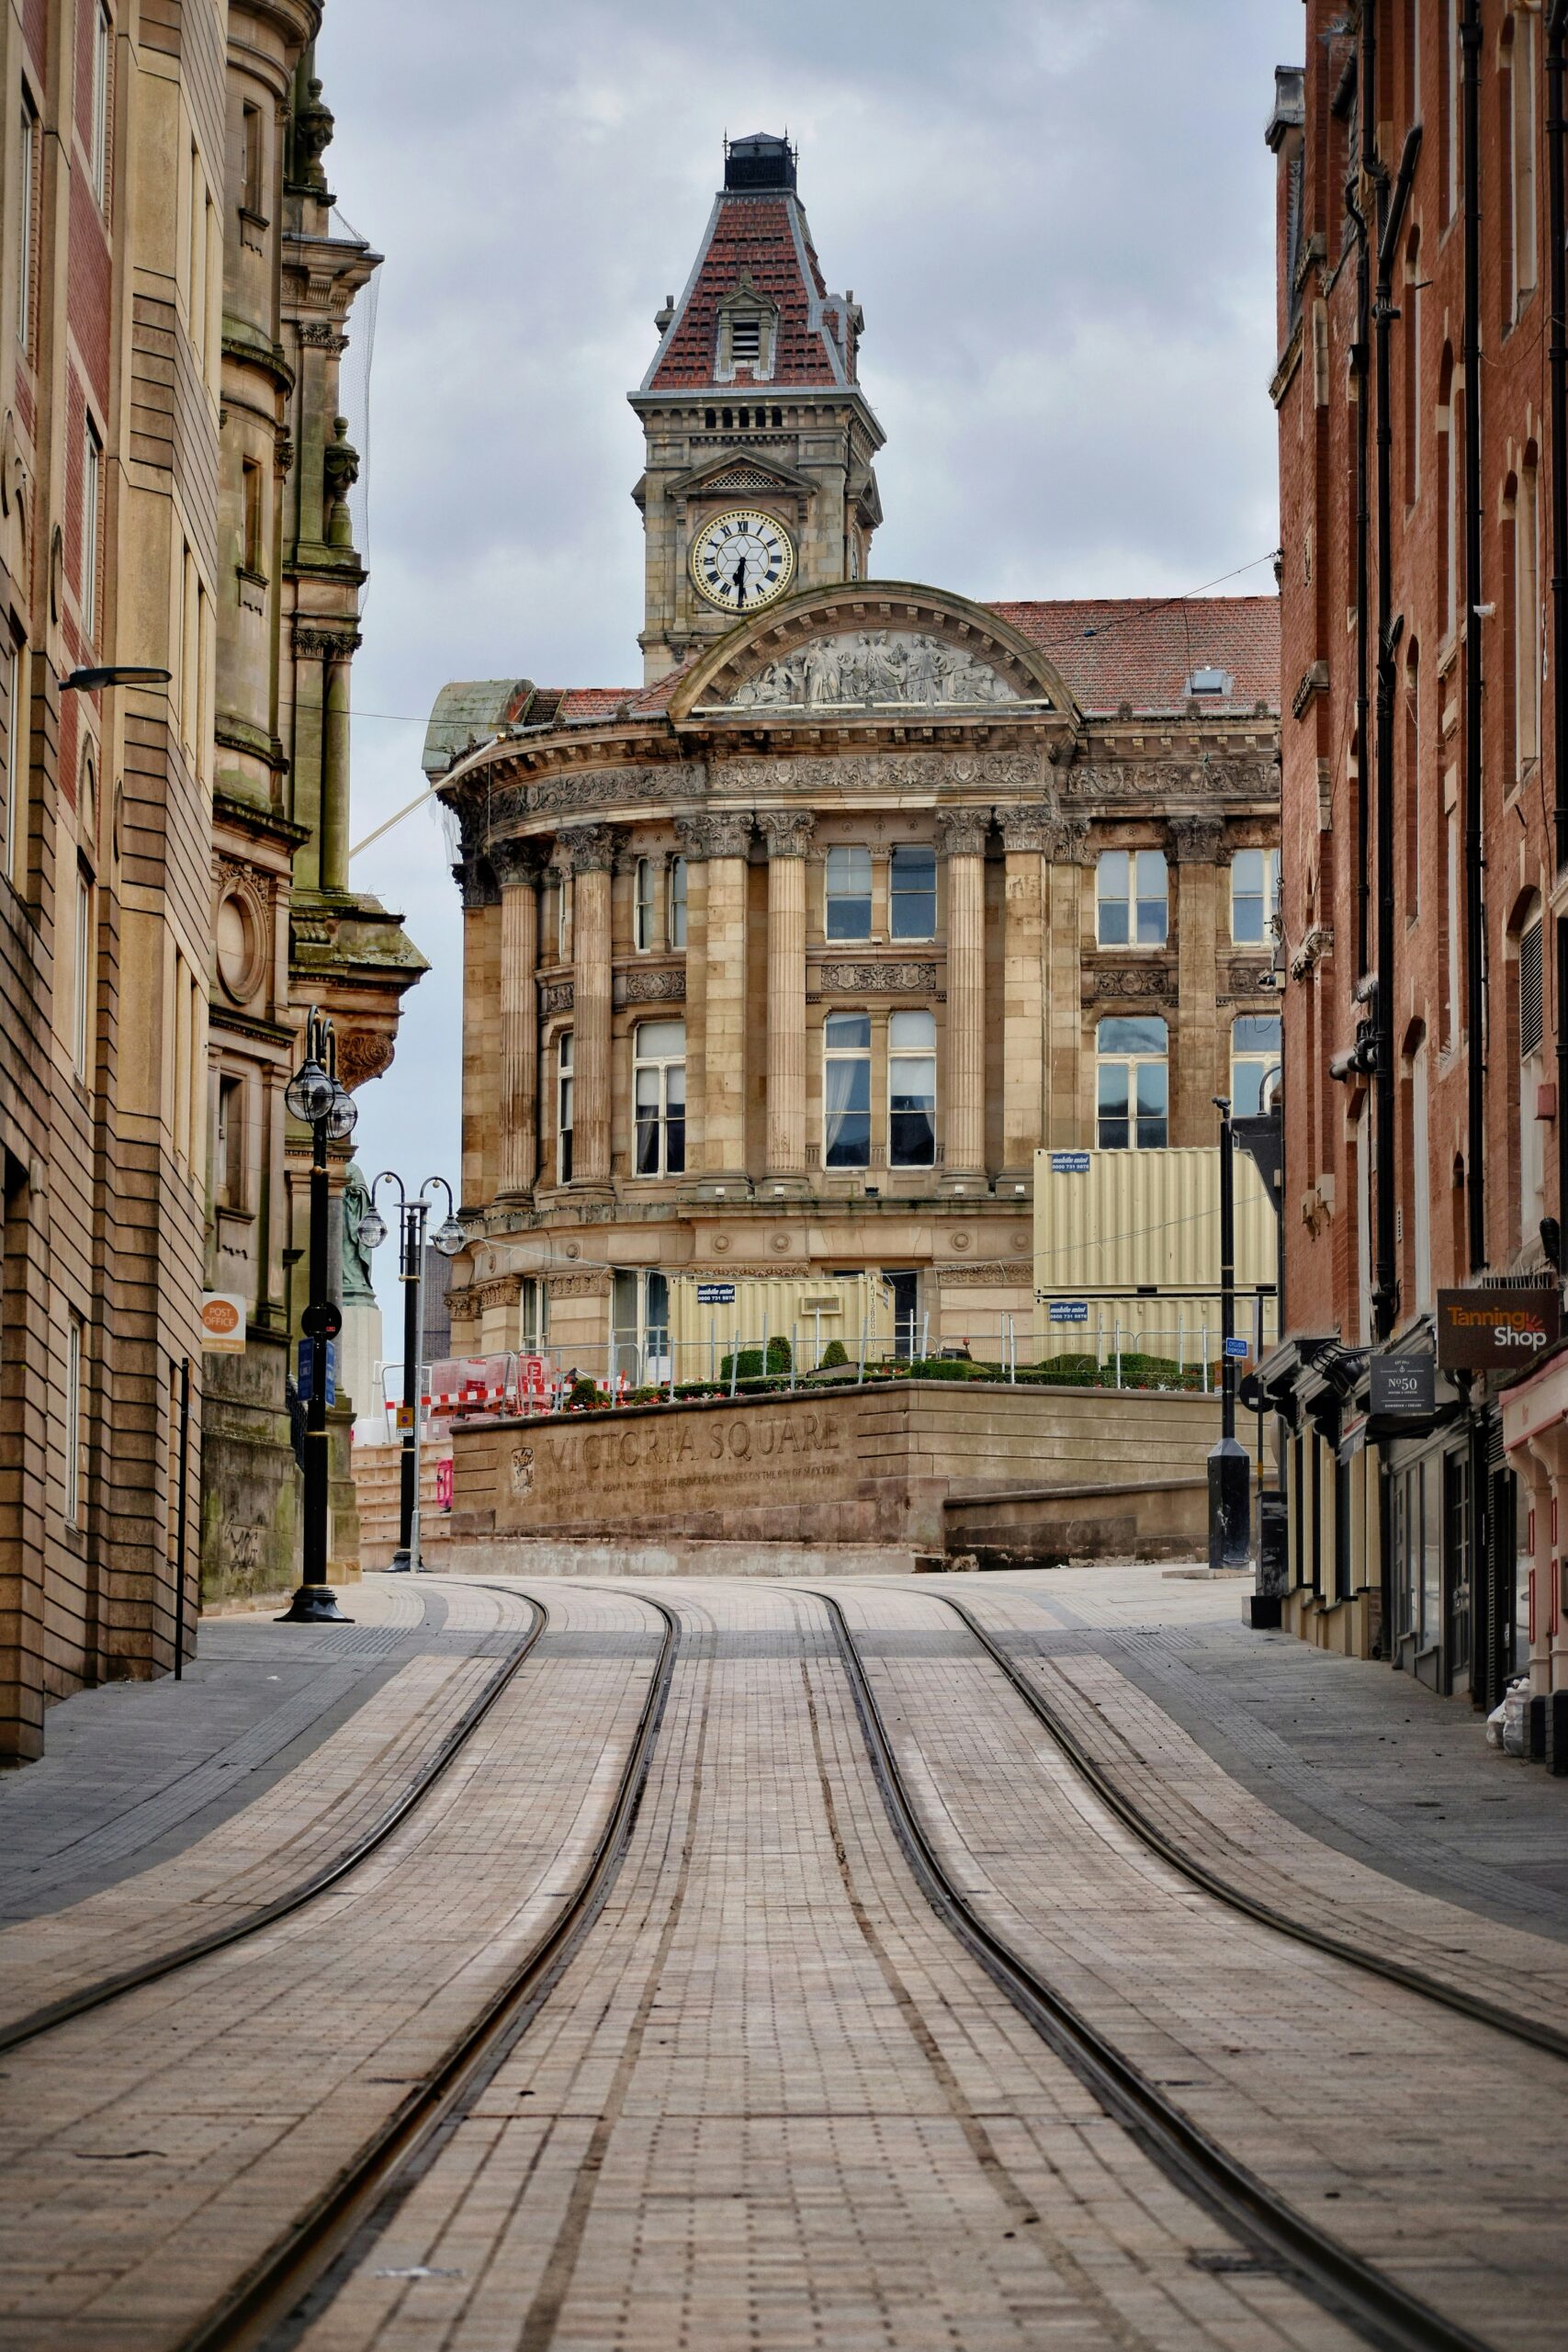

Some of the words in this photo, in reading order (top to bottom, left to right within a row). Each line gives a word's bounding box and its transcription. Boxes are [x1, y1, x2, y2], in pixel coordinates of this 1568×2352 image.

[209, 1307, 231, 1317] POST
[204, 1317, 235, 1328] OFFICE
[1447, 1306, 1526, 1331] Tanning
[1494, 1326, 1547, 1351] Shop
[1228, 1340, 1246, 1349] CYCLISTS
[1227, 1347, 1247, 1355] DISMOUNT
[546, 1425, 699, 1473] VICTORIA
[709, 1412, 840, 1462] SQUARE
